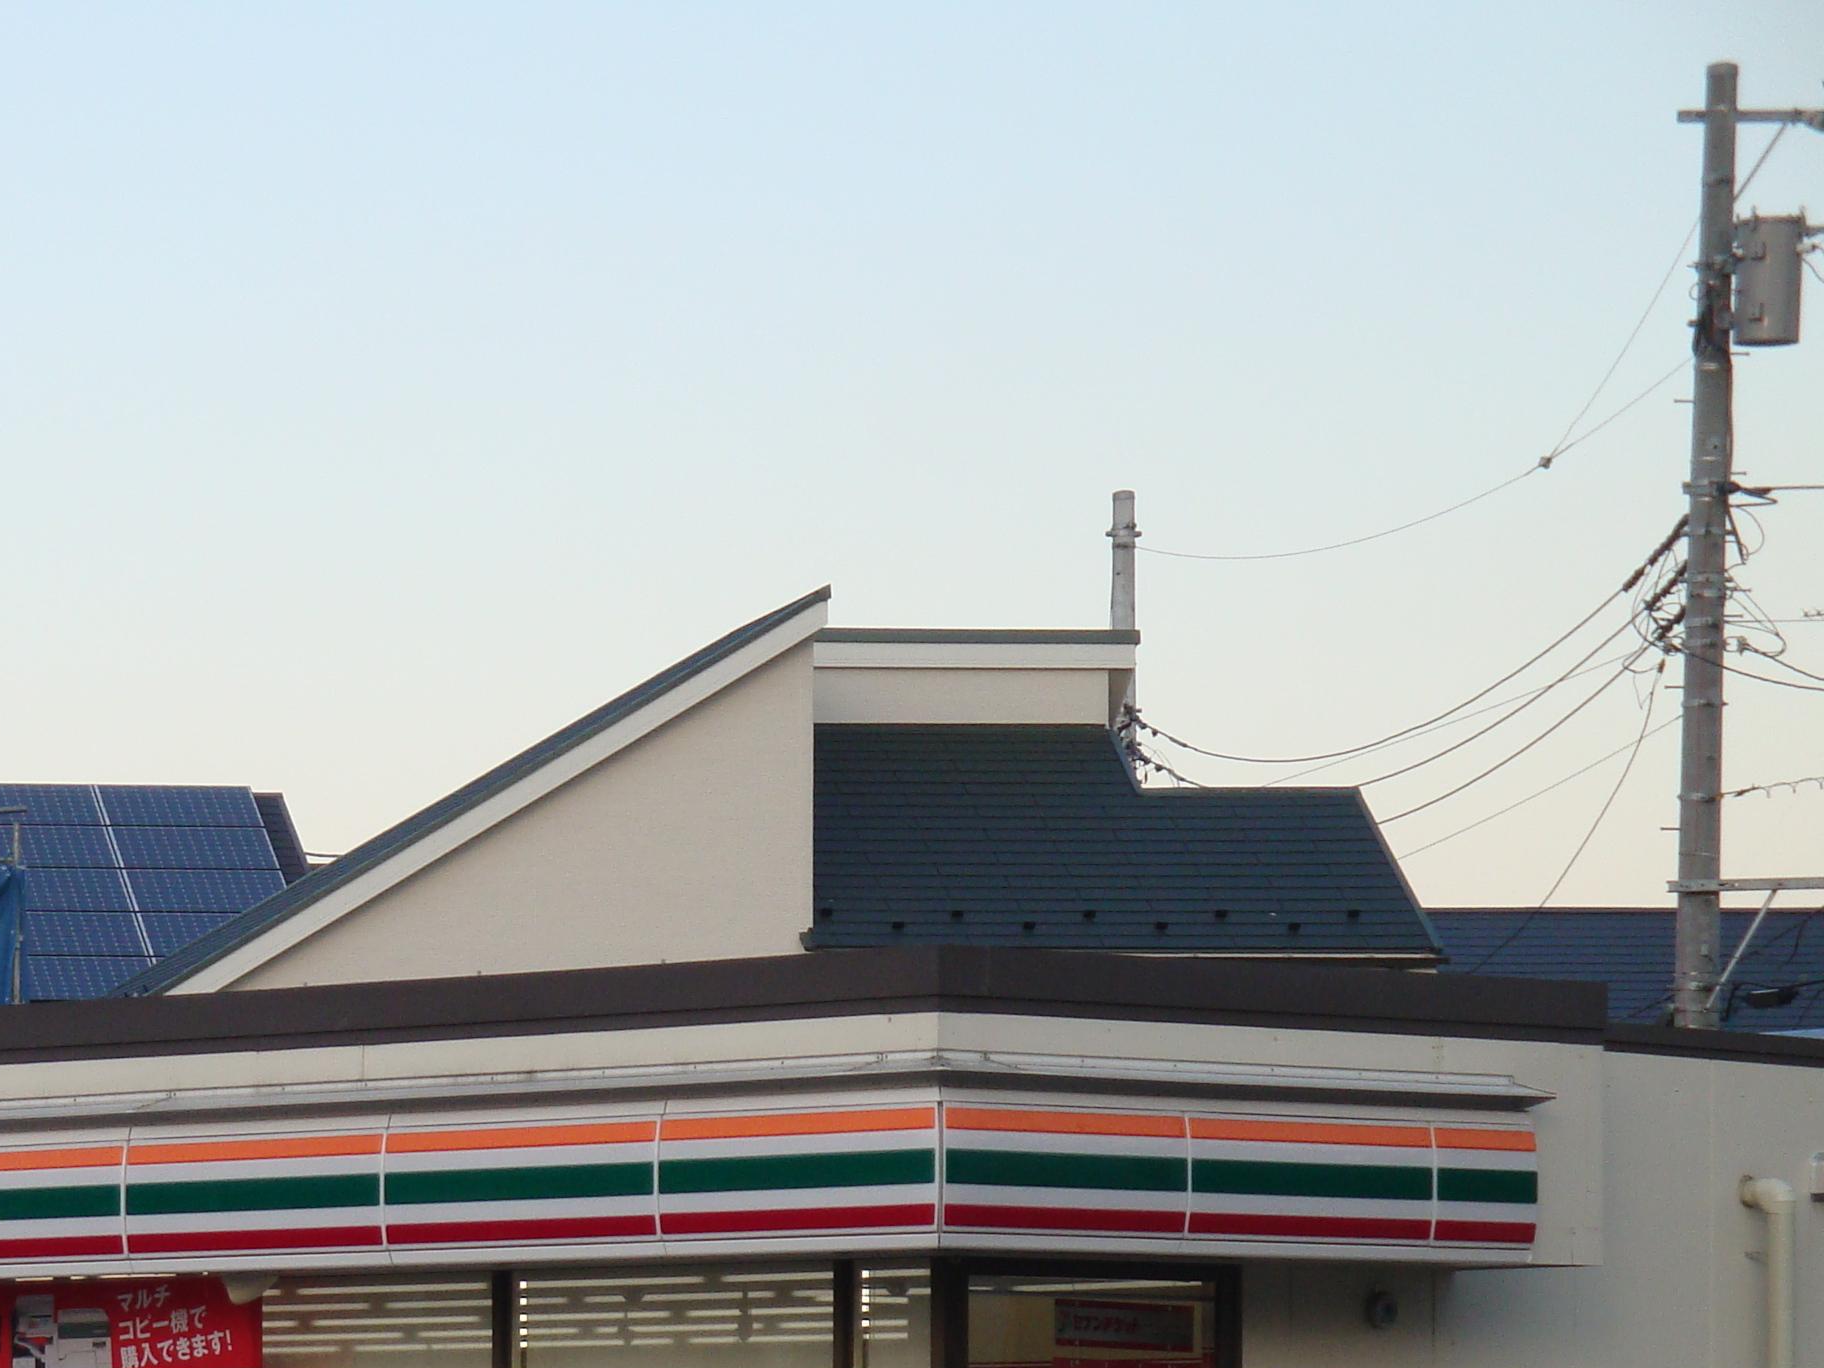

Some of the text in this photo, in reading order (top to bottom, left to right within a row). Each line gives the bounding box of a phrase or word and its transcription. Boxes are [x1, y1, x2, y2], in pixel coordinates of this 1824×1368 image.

[116, 1283, 171, 1312] マルチ
[118, 1304, 208, 1341] コピー機で
